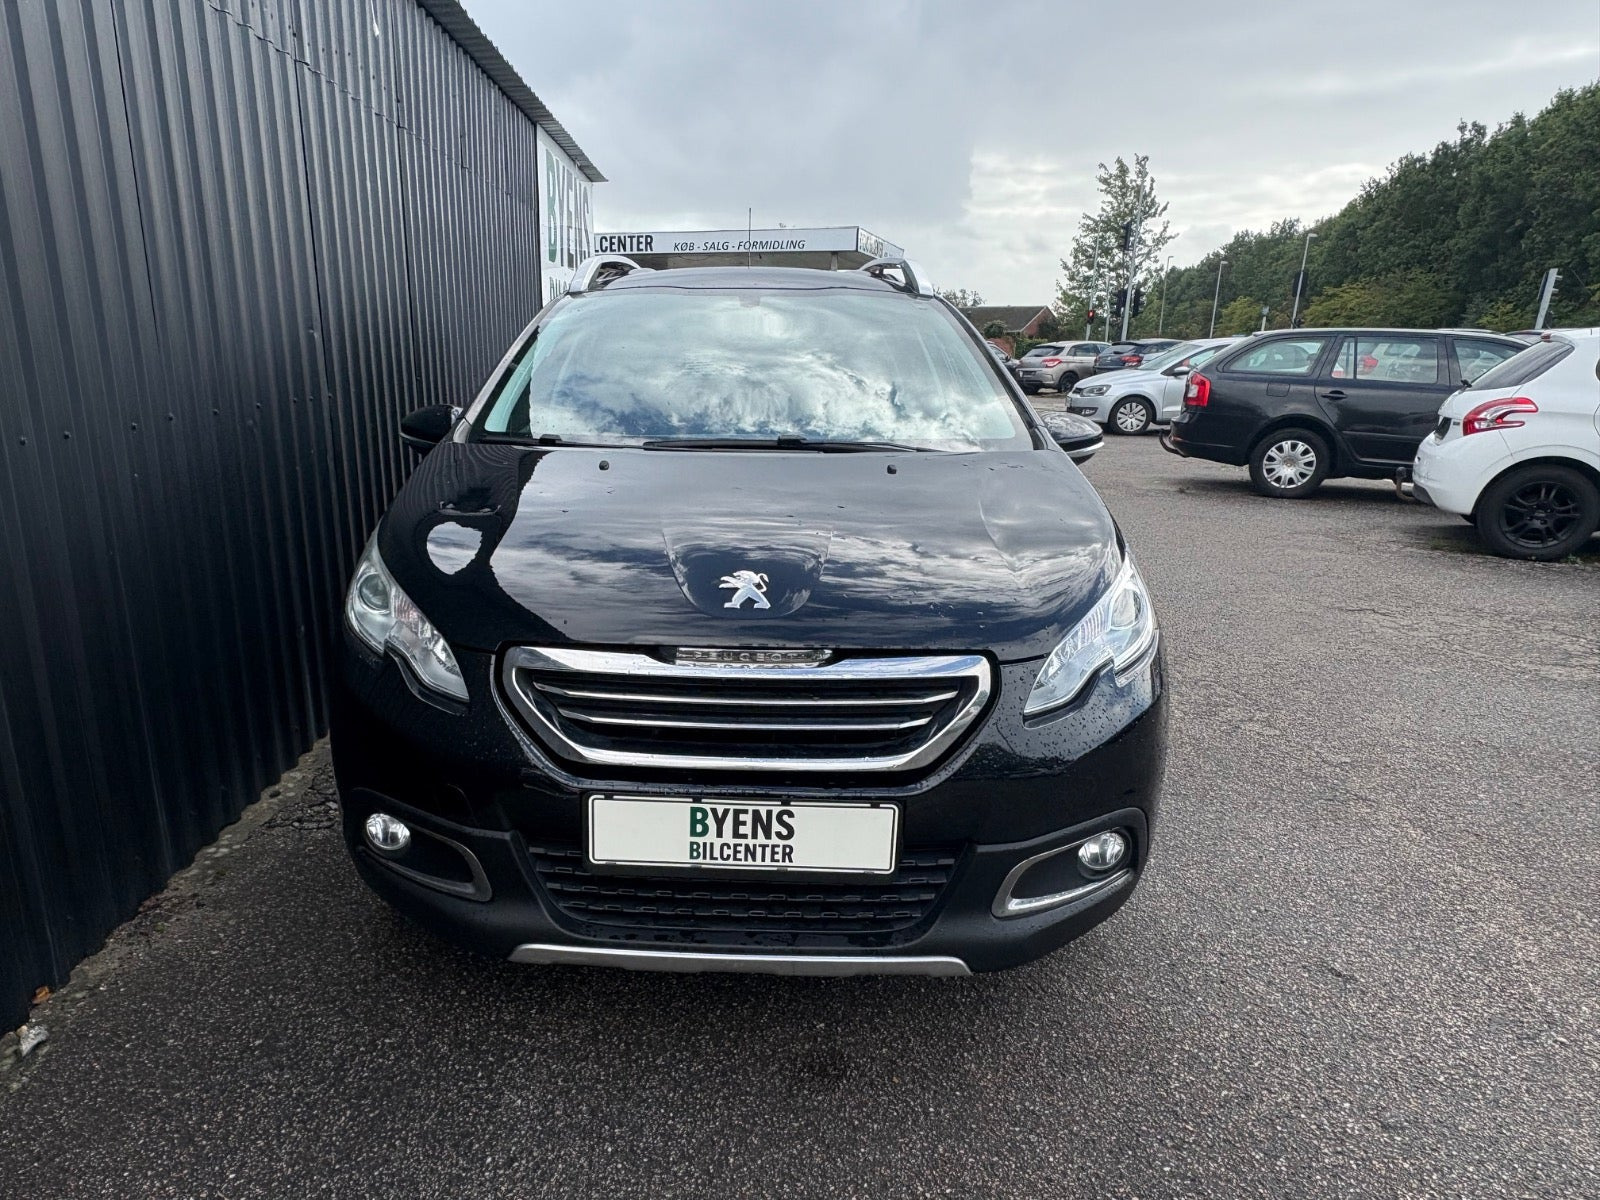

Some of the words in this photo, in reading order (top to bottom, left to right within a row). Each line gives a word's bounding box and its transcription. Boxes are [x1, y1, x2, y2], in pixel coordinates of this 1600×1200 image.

[546, 149, 591, 270] BYENS
[673, 242, 695, 251] KØB
[702, 241, 729, 251] SALG
[738, 240, 806, 250] FORMIDLING
[690, 807, 795, 840] BYENS
[689, 841, 794, 863] BILCENTER
